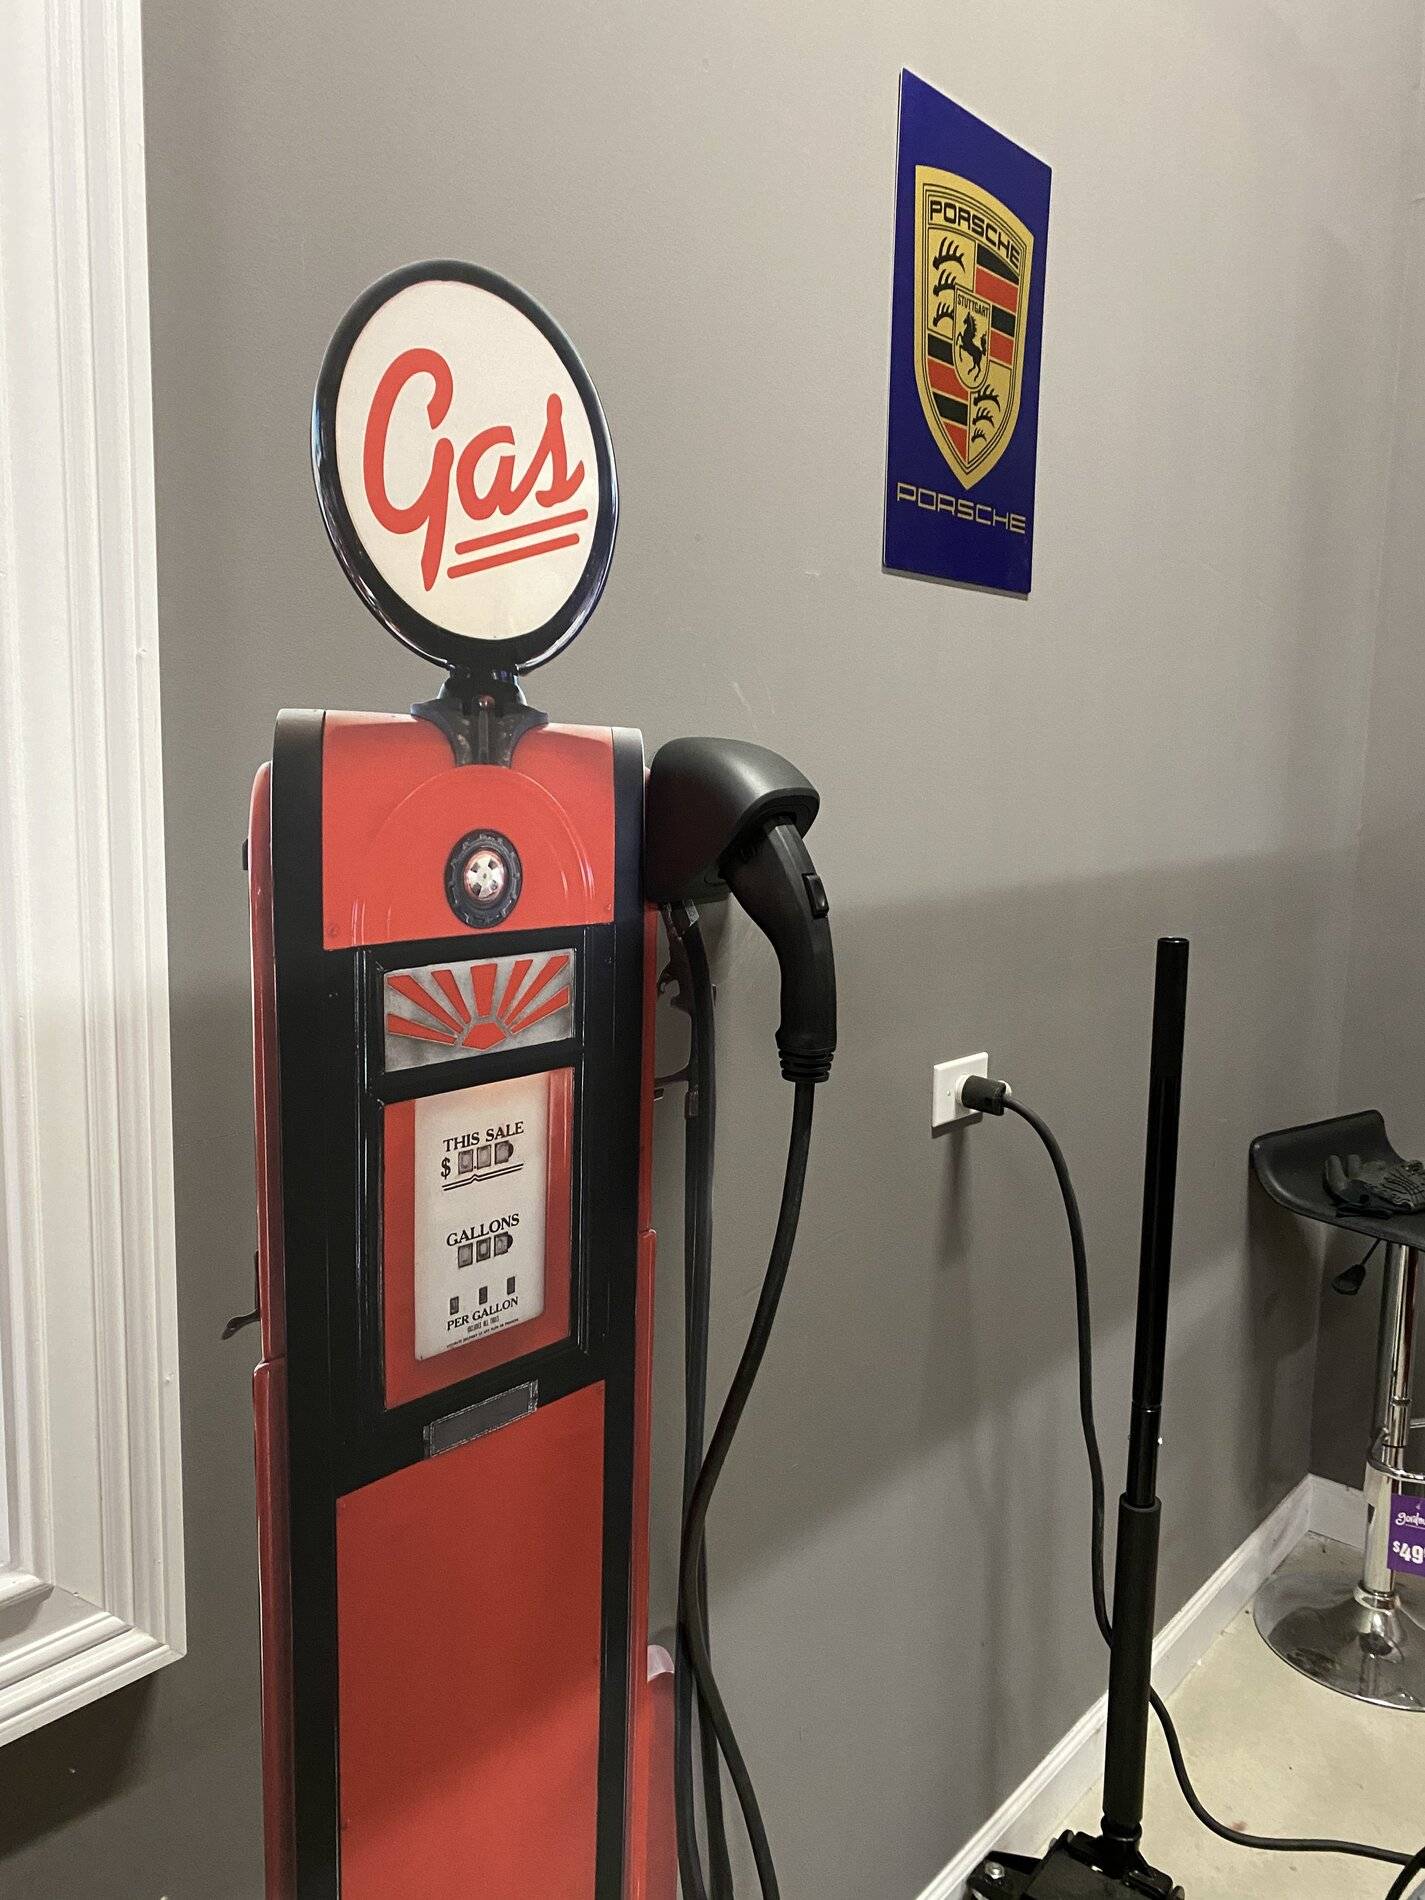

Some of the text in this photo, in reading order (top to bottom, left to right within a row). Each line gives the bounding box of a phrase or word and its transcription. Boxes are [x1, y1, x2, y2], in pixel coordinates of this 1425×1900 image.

[929, 200, 1021, 263] PORSCHE
[363, 348, 585, 592] Gas
[896, 482, 1026, 534] PORSCHE
[443, 1121, 524, 1152] THIS SALE
[446, 1213, 520, 1246] GALLONS
[447, 1315, 469, 1331] PER
[472, 1296, 519, 1321] GALLON
